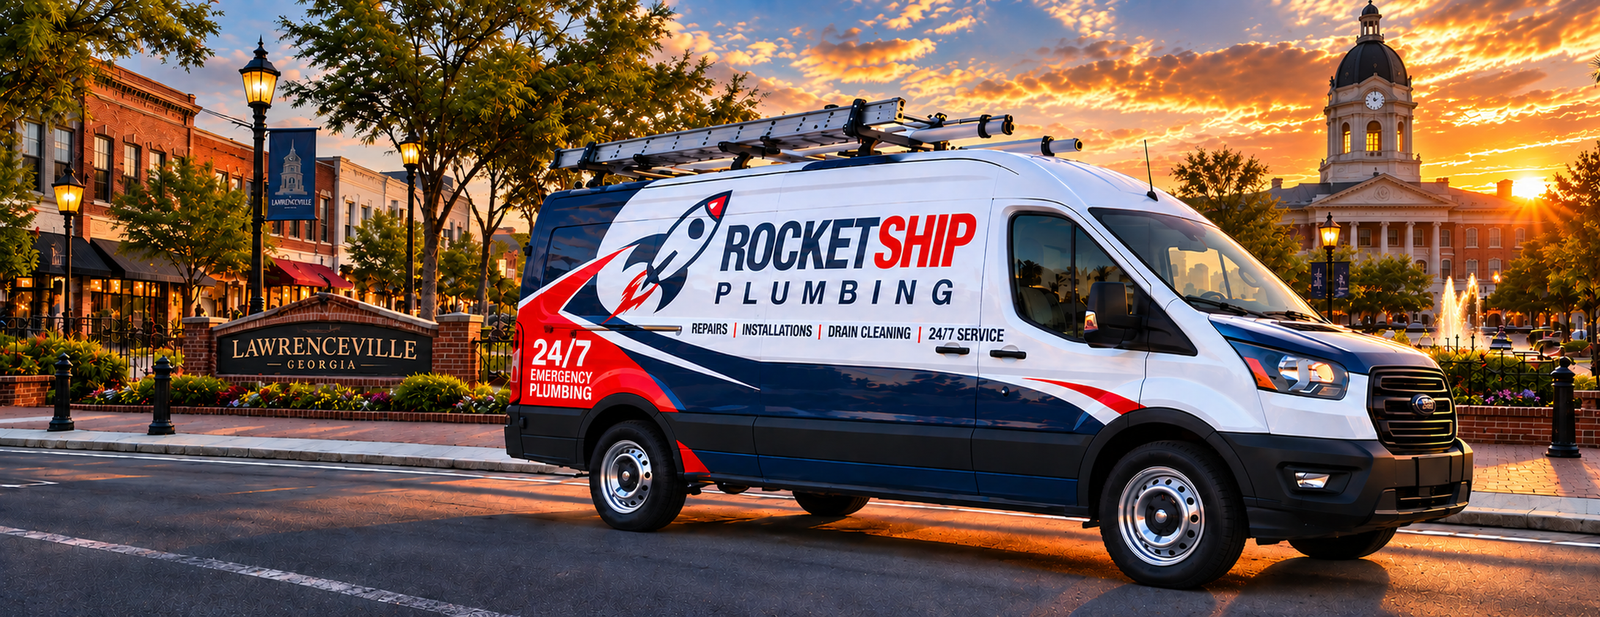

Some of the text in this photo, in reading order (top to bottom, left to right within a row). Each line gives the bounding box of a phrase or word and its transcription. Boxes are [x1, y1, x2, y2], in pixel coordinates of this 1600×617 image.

[719, 212, 977, 271] ROCKETSHIP
[714, 279, 953, 305] PLUMBING
[691, 322, 1005, 342] REPAIRS INSTALLATIONS DRAIN CLEANING 24/7 SERVICE
[232, 336, 417, 360] LAWRENCEVILLE
[531, 338, 592, 368] 24/7
[287, 359, 356, 370] GEORGIA
[530, 368, 593, 384] EMERGENCY
[529, 383, 592, 400] PLUMBING
